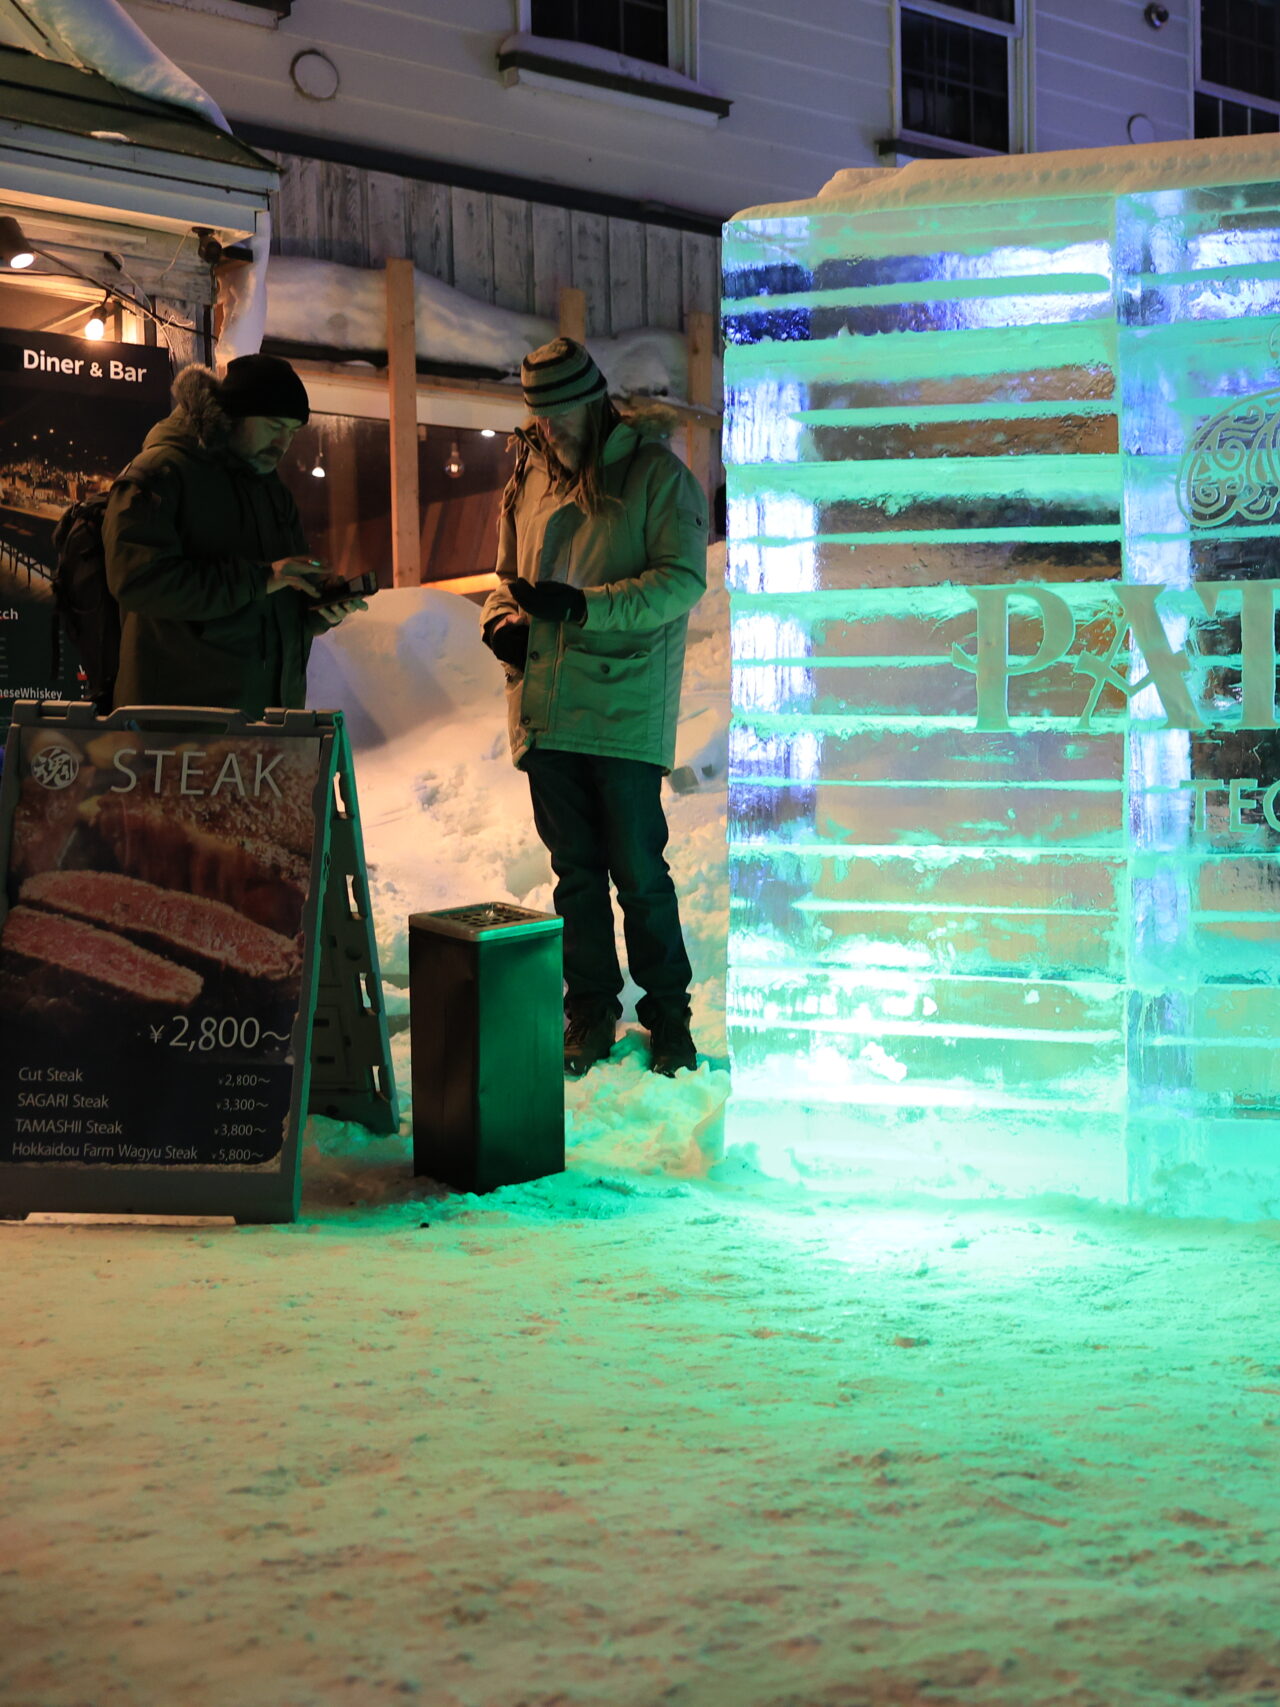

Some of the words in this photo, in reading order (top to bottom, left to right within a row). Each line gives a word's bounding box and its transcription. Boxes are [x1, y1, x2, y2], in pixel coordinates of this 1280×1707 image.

[23, 349, 85, 375] Diner
[89, 362, 103, 378] &
[109, 360, 147, 382] Bar
[110, 748, 285, 798] STEAK
[18, 1067, 42, 1081] Cut
[47, 1067, 83, 1082] Steak
[17, 1093, 69, 1108] SAGARI
[72, 1094, 110, 1108] Steak
[16, 1118, 82, 1133] TAMASHII
[86, 1120, 123, 1134] Steak
[12, 1142, 80, 1156] Hokkaidou
[83, 1143, 114, 1157] Farm
[118, 1144, 161, 1161] Wagyu
[164, 1145, 198, 1160] Steak
